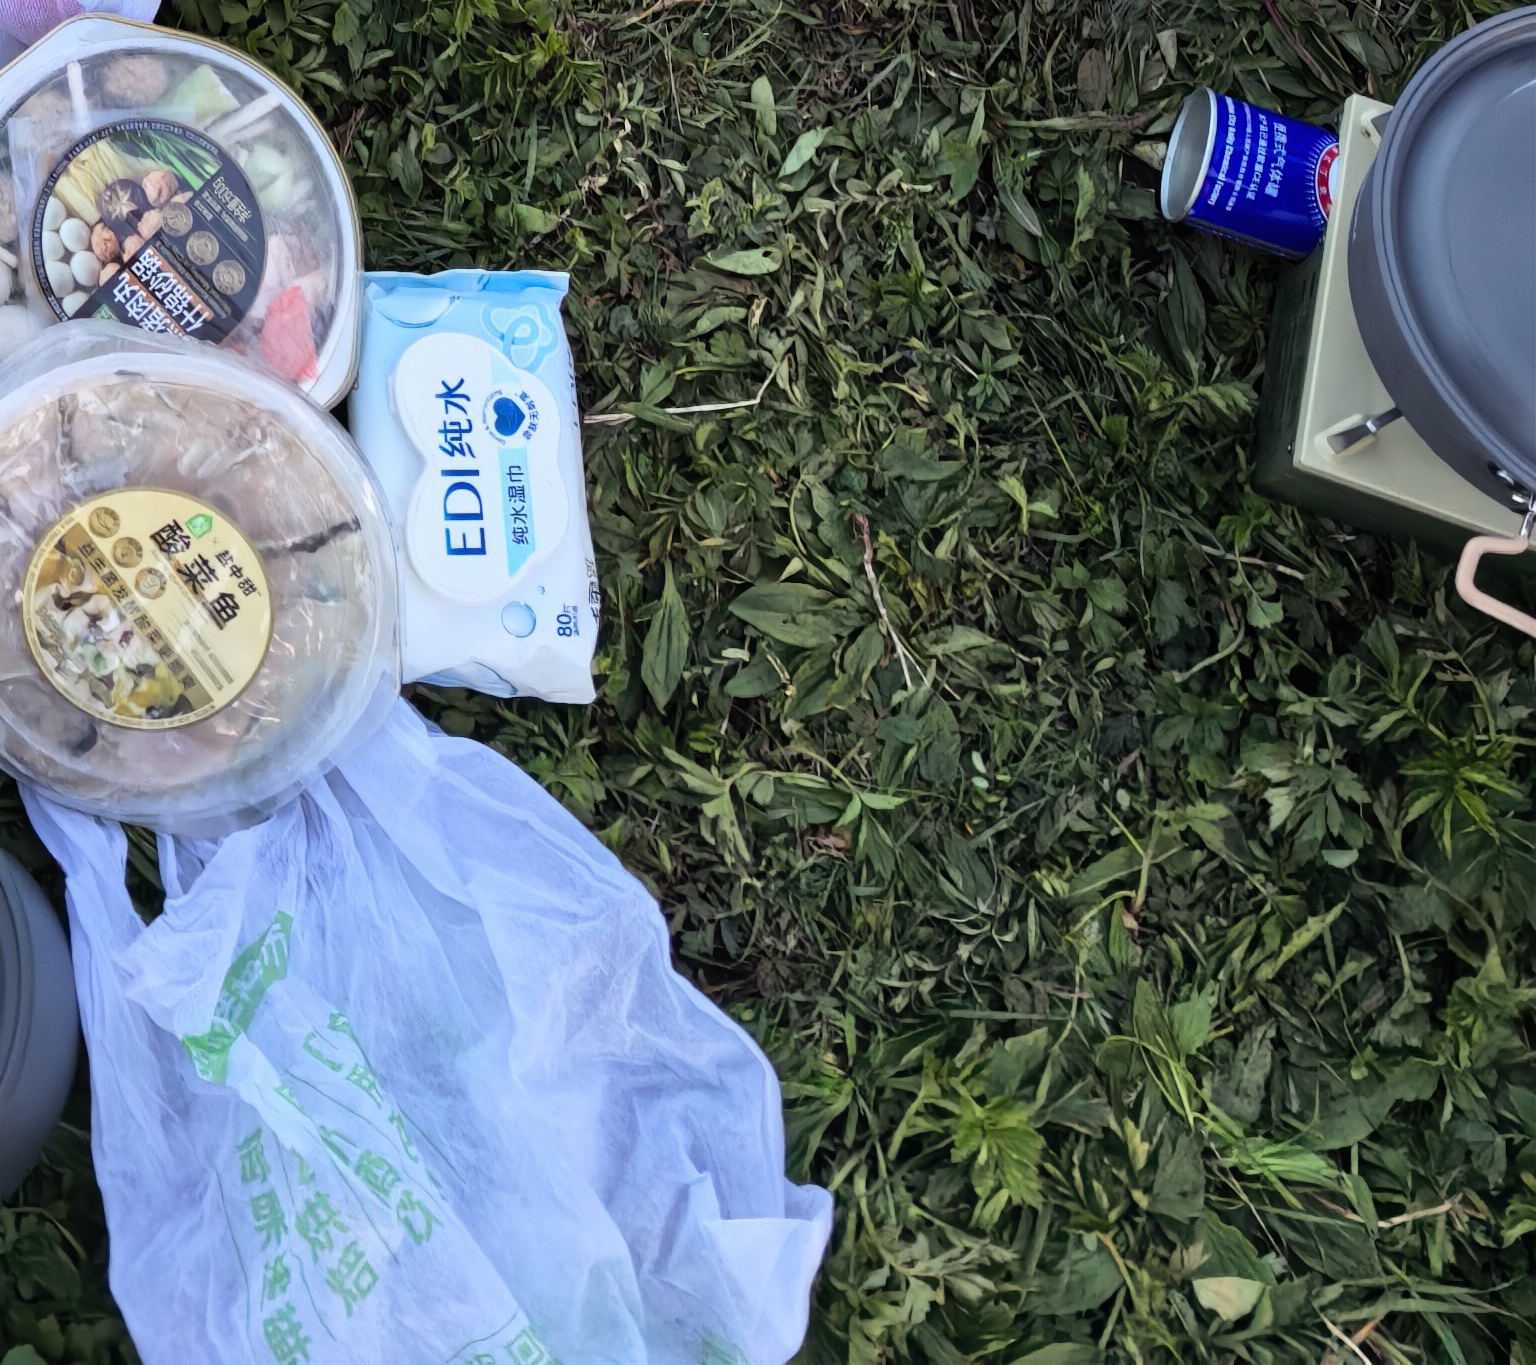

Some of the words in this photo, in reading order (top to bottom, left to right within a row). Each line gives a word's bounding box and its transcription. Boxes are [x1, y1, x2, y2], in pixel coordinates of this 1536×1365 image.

[136, 249, 215, 333] 什锦砂锅
[434, 376, 476, 458] 纯水
[443, 469, 486, 556] EDI
[505, 465, 531, 546] 纯水湿巾
[148, 518, 242, 631] 酸菜鱼
